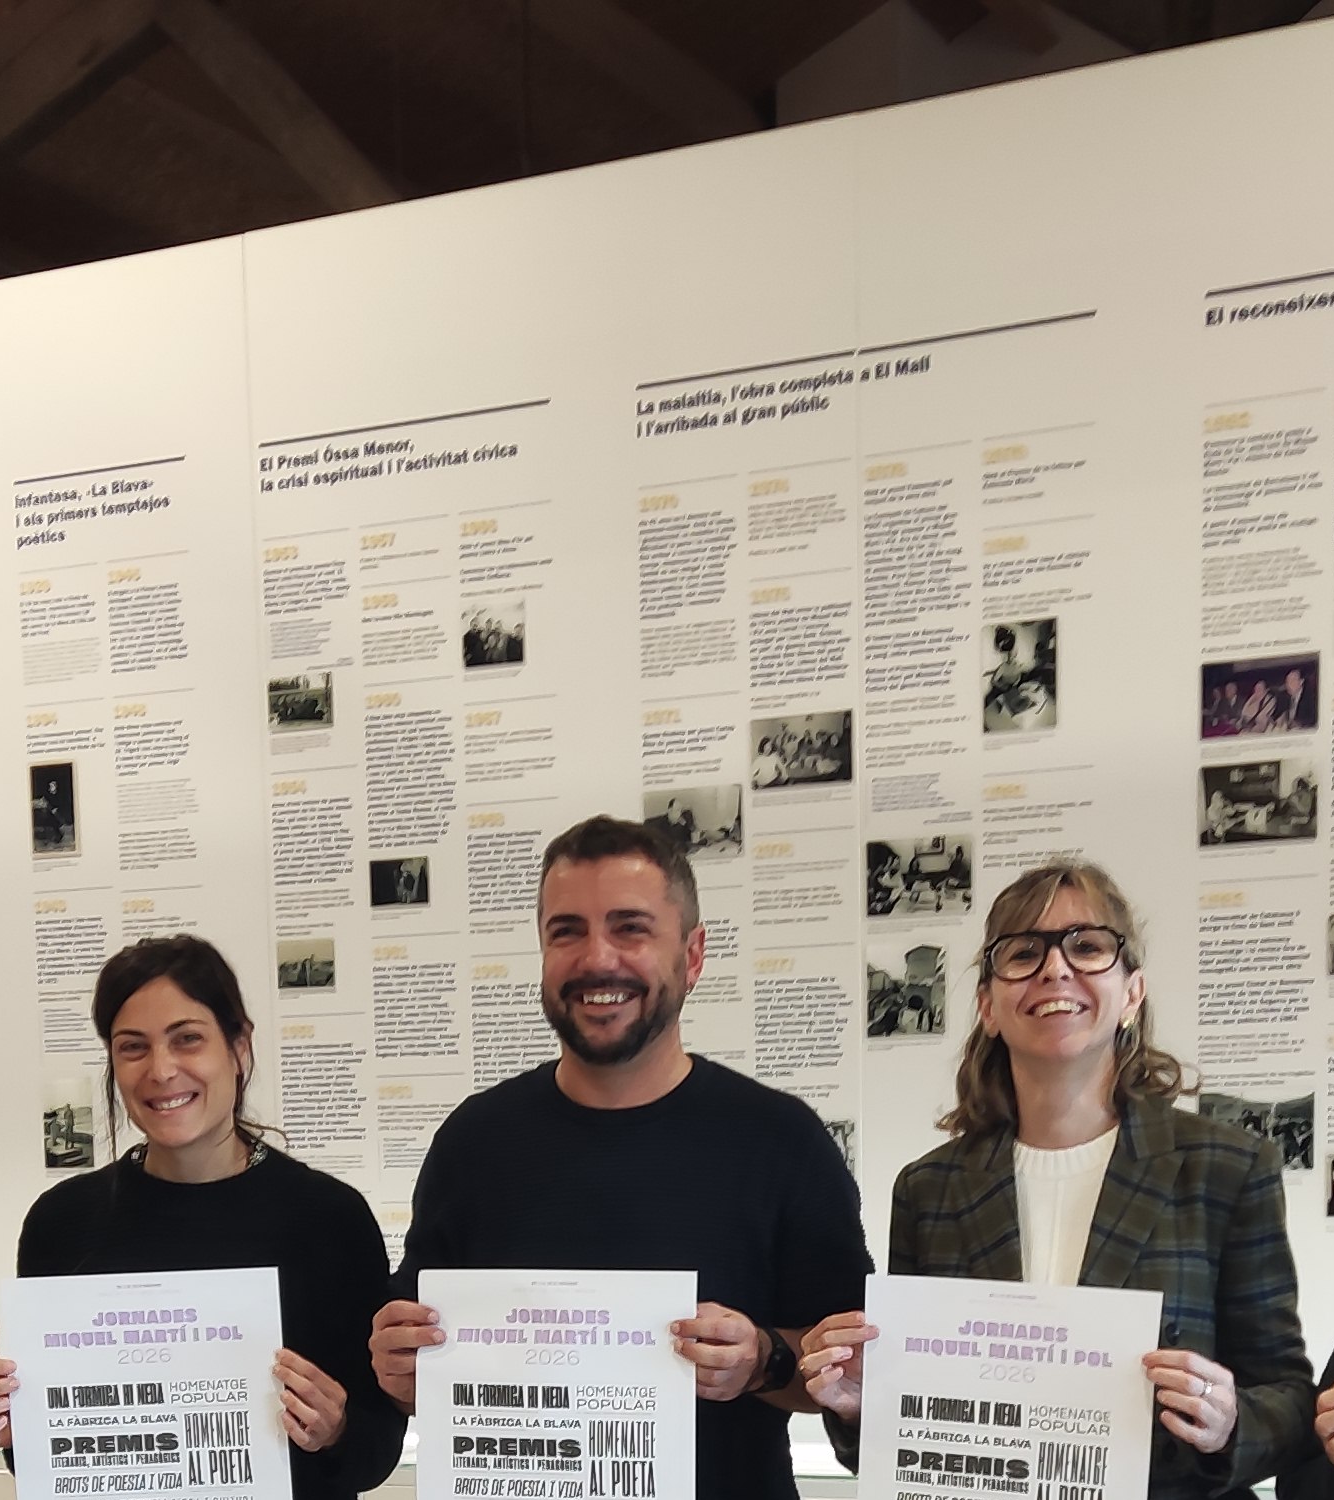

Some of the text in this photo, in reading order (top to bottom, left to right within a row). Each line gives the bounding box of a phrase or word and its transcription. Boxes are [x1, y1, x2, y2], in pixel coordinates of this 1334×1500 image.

[1205, 307, 1223, 326] El
[637, 400, 654, 416] La
[875, 361, 890, 380] El
[895, 354, 931, 376] Mall
[723, 408, 737, 424] al
[741, 404, 776, 425] gran
[781, 395, 830, 420] públic
[260, 456, 272, 472] El
[92, 1308, 197, 1327] JORNADES
[506, 1309, 610, 1324] JORNADES
[44, 1323, 243, 1349] MIQUEL MARTÍ I POL
[457, 1326, 656, 1345] MIQUEL MARTÍ I POL
[957, 1320, 1068, 1343] JORNADES
[118, 1348, 171, 1364] 2026
[525, 1350, 580, 1366] 2026
[905, 1337, 1113, 1367] MIQUEL MARTÍ I POL
[979, 1363, 1035, 1383] 2026
[453, 1383, 569, 1409] UNA FORMIGA HI NEDA
[49, 1414, 177, 1427] LA FÀBRICA LA BLAVA
[51, 1433, 179, 1456] PREMIS
[453, 1436, 581, 1458] PREMIS
[896, 1449, 1029, 1480] PREMIS
[55, 1473, 182, 1493] BROTS DE POESIA I VIDA
